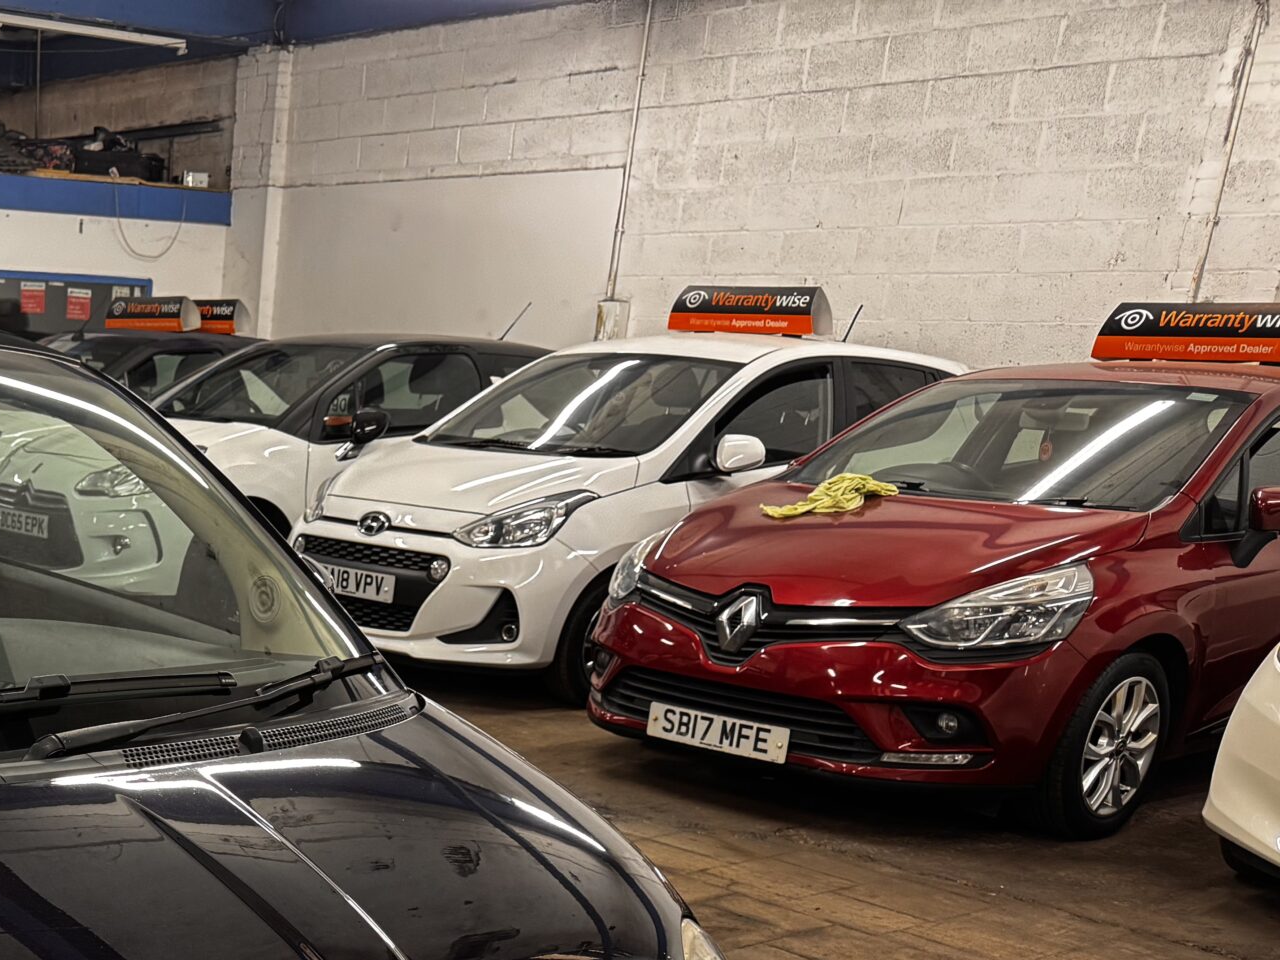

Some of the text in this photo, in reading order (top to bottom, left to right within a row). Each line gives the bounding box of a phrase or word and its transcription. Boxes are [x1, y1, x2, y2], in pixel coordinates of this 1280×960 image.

[711, 291, 811, 311] Warrantywise
[731, 318, 764, 328] Approved
[765, 319, 789, 328] Dealer
[1159, 310, 1280, 333] Warrantywi
[1124, 341, 1273, 355] Warrantywise Approved Dealer
[24, 515, 46, 536] EPK
[355, 571, 385, 596] VPV
[662, 707, 772, 754] SB17 MFE
